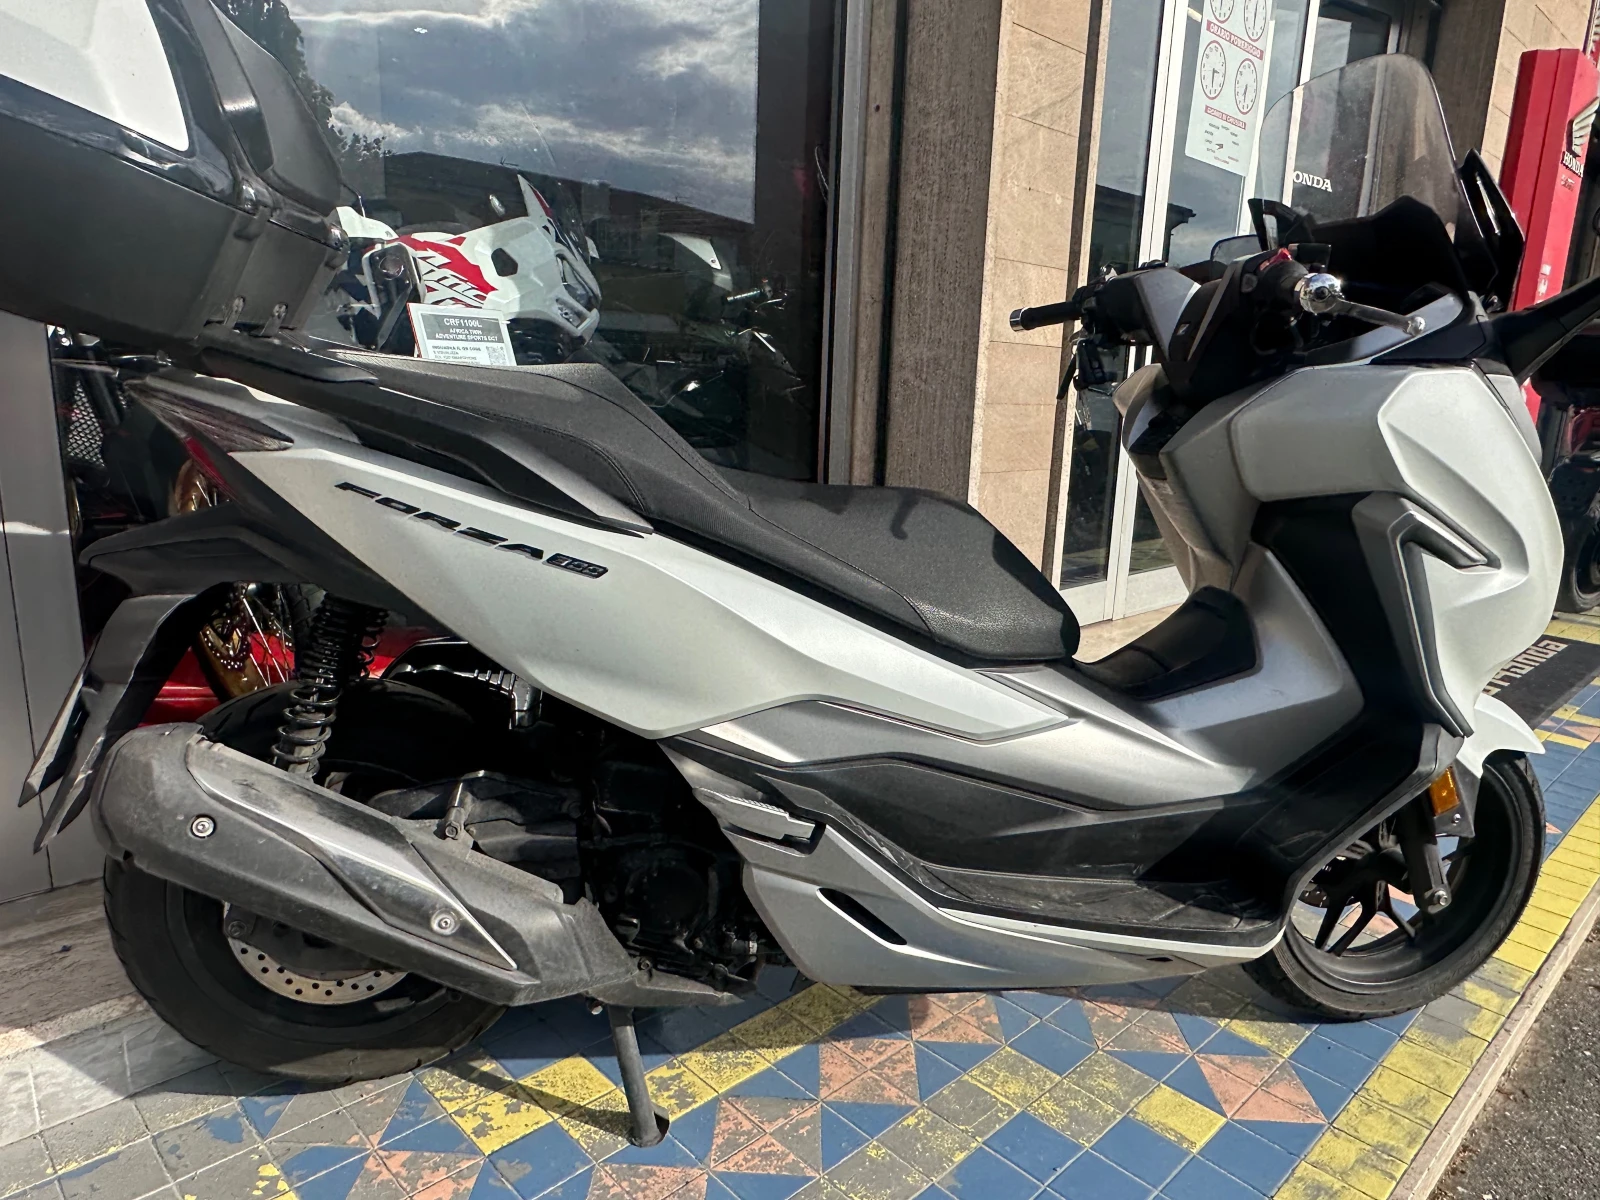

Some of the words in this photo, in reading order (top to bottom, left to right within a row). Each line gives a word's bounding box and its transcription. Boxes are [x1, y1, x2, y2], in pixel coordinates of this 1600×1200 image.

[1562, 151, 1584, 178] HONDA
[1293, 170, 1333, 193] ONDA
[443, 317, 483, 328] CRF1100L
[435, 332, 467, 340] ADVENTURE
[334, 481, 544, 560] FORZA
